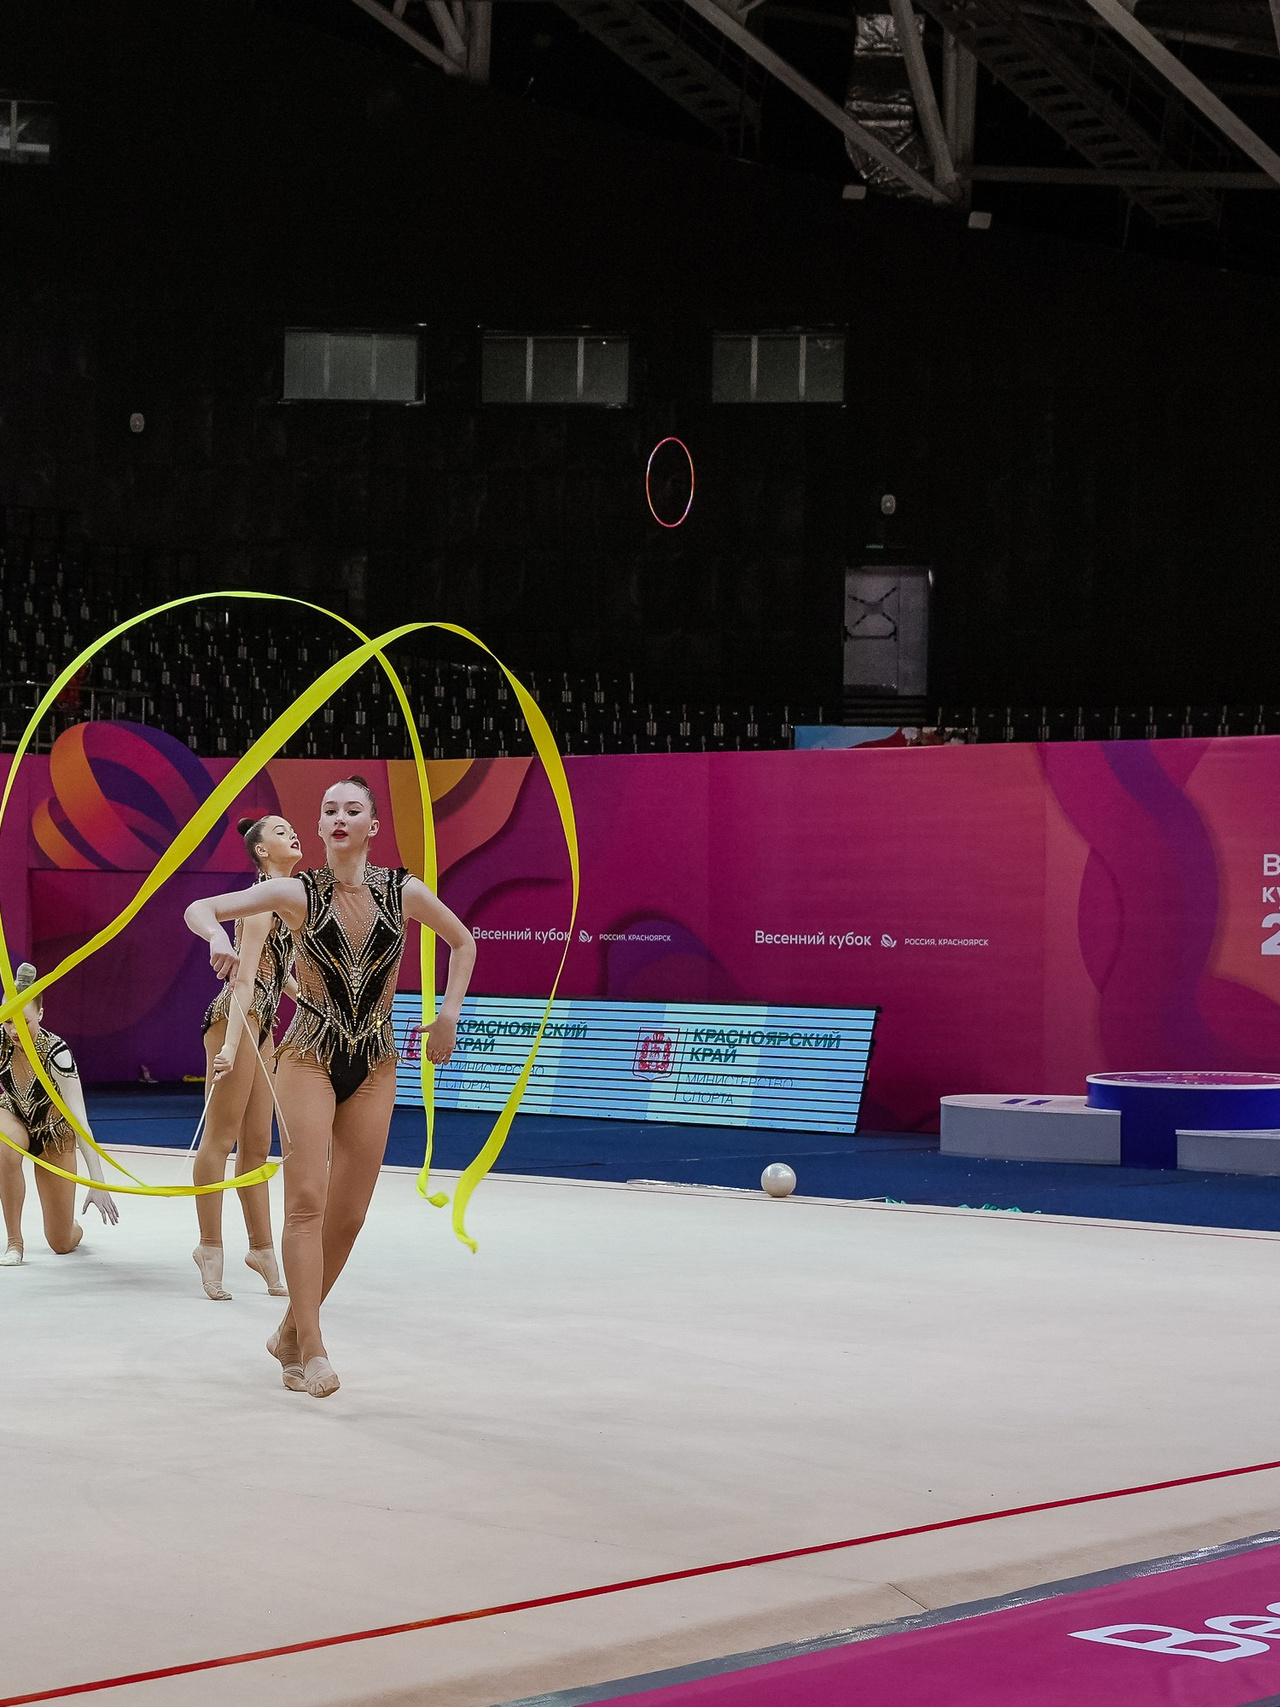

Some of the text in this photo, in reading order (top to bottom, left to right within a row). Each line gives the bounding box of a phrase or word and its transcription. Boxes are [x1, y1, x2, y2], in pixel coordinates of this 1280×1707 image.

[472, 926, 532, 941] Весенний
[599, 933, 627, 942] РОССИЯ,
[628, 934, 671, 942] КРАСНОЯРСК
[754, 930, 989, 949] Весенний кубок РОССИЯ, КРАСНОЯРСК
[693, 1028, 842, 1048] КРАСНОЯРСКИЙ
[689, 1046, 737, 1063] КРАЙ
[685, 1073, 794, 1089] МИНИСТЕРСТВО
[682, 1091, 734, 1105] СПОРТА
[1067, 1601, 1280, 1663] Ве
